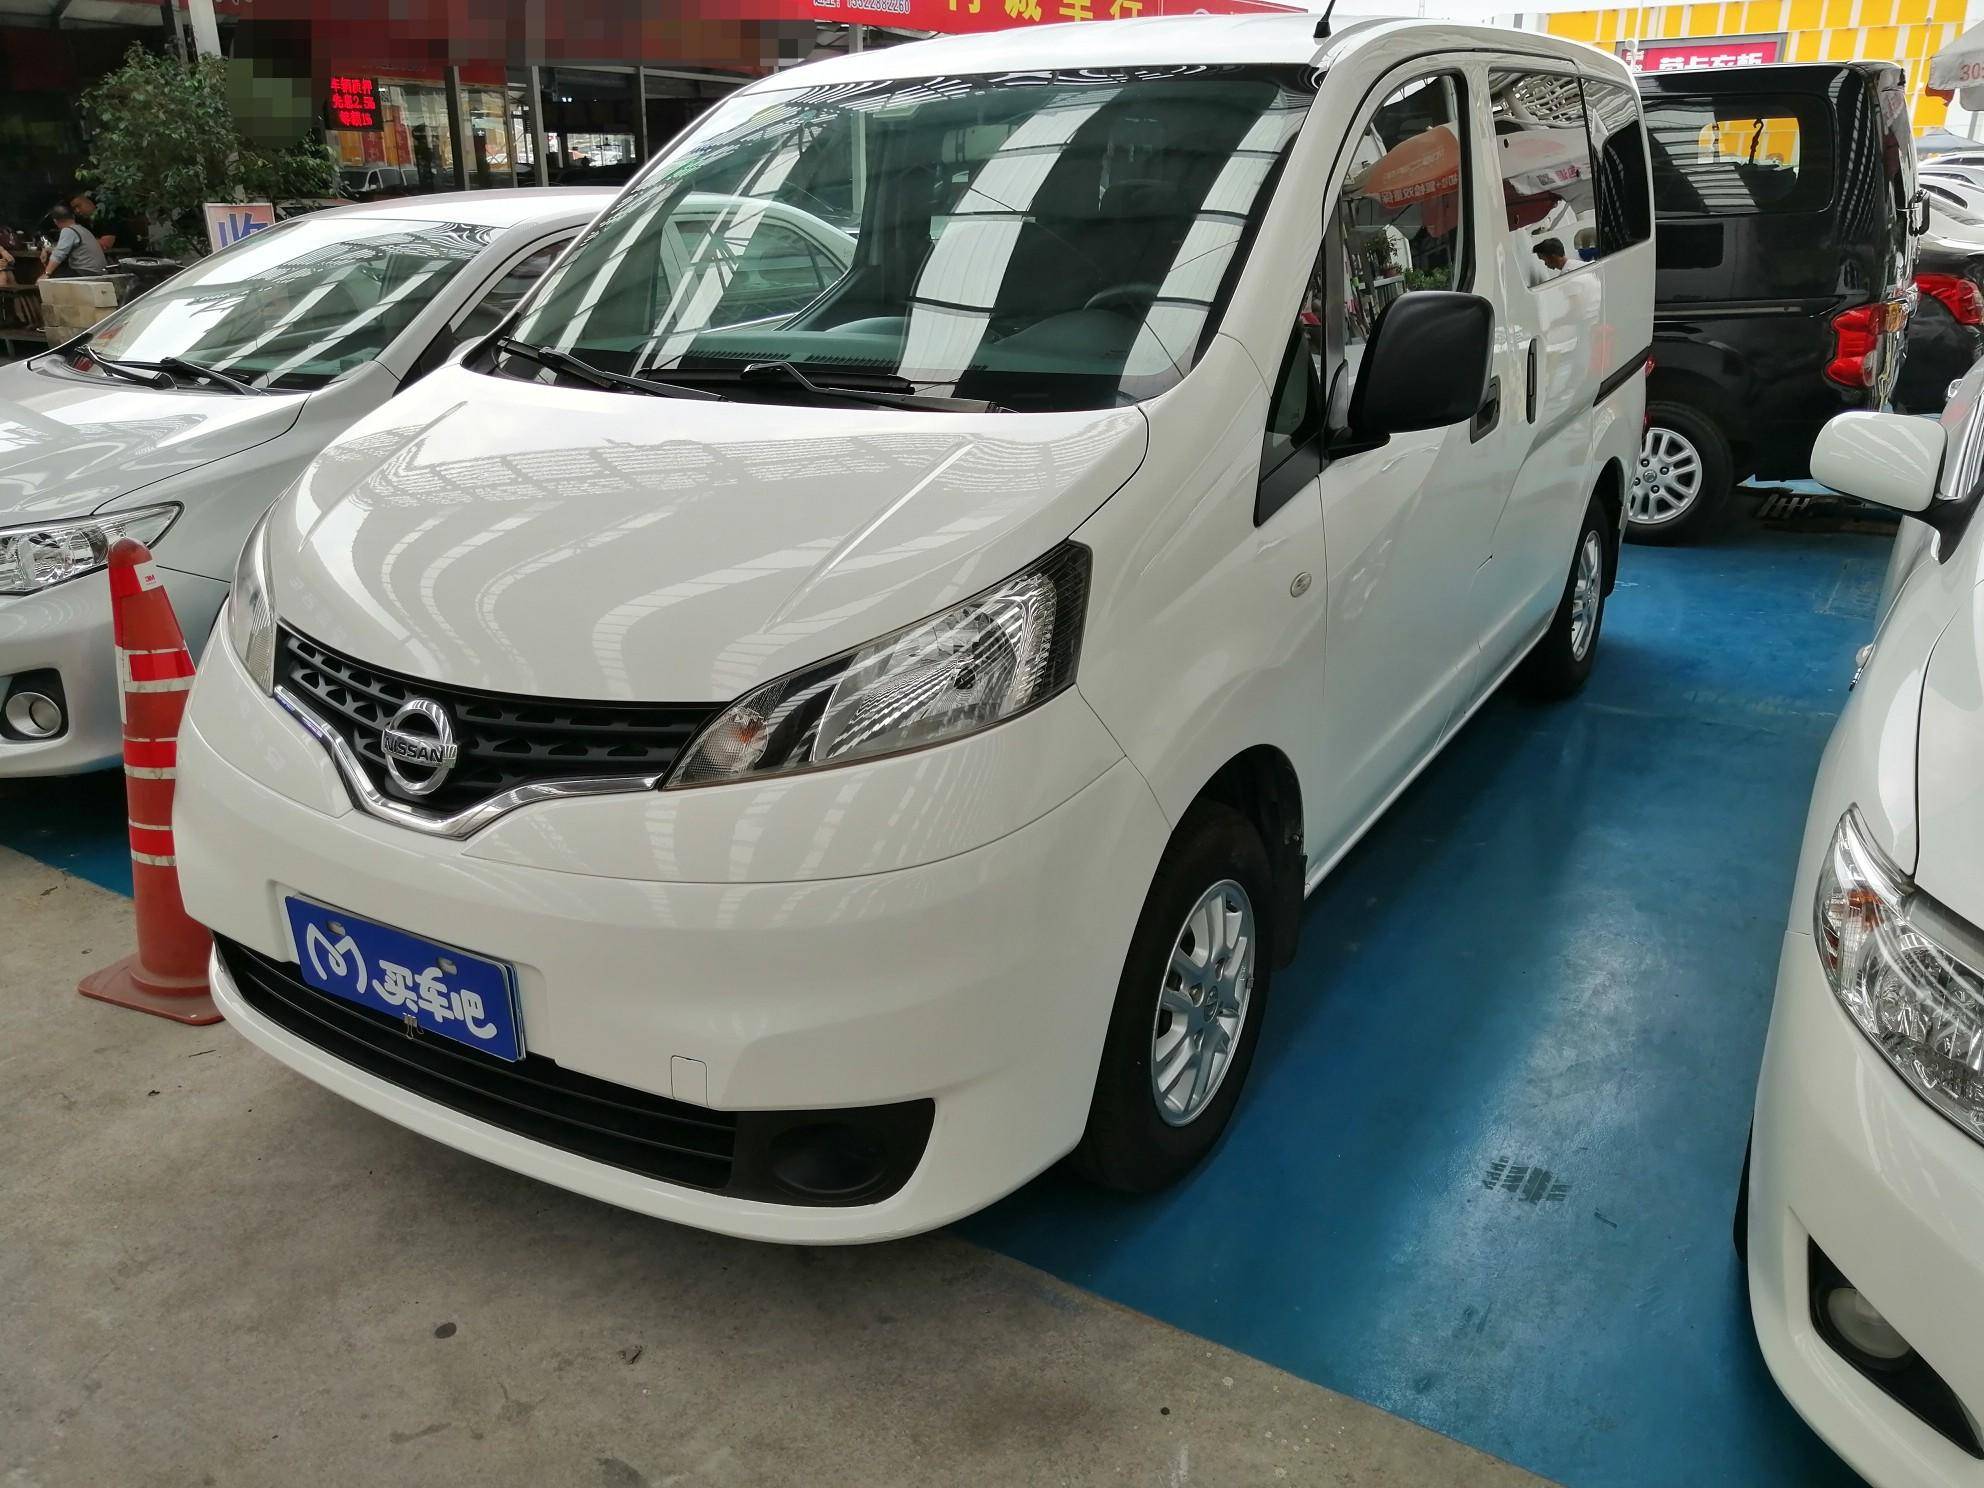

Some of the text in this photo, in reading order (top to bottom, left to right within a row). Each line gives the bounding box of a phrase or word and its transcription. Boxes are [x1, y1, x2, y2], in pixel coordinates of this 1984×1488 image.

[384, 735, 444, 763] NISSAN
[372, 959, 498, 1040] 买车吧
